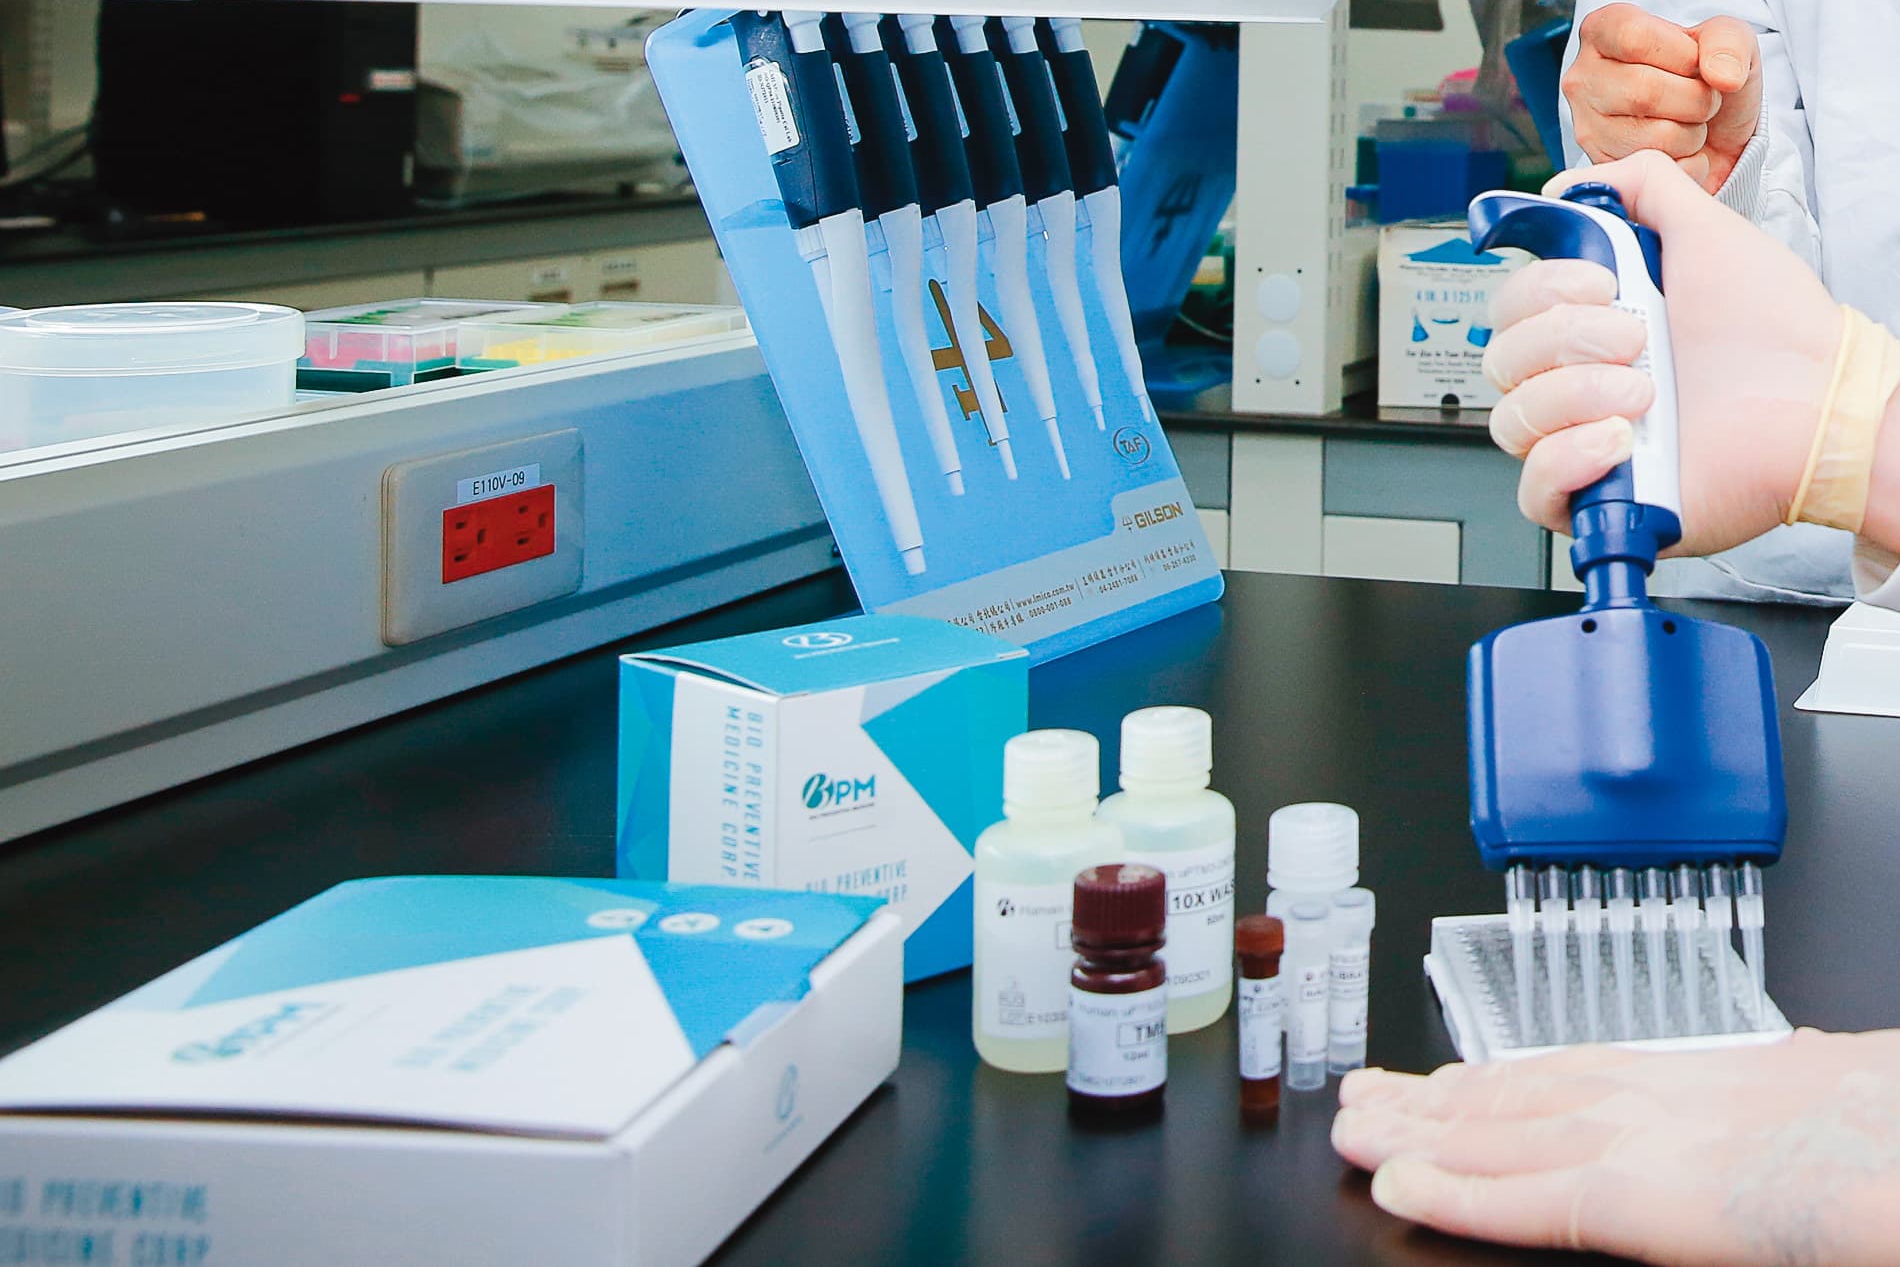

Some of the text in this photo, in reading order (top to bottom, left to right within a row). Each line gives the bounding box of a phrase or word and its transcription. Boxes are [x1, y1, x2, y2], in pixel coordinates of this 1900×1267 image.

[1120, 437, 1142, 454] TAF
[472, 471, 526, 495] E110V-09
[1134, 501, 1184, 529] GILSON
[722, 705, 742, 807] MEDICINE
[744, 712, 763, 882] BIO PREVENTIVE
[836, 858, 907, 892] PREVENTIVE
[1173, 892, 1205, 910] 10X
